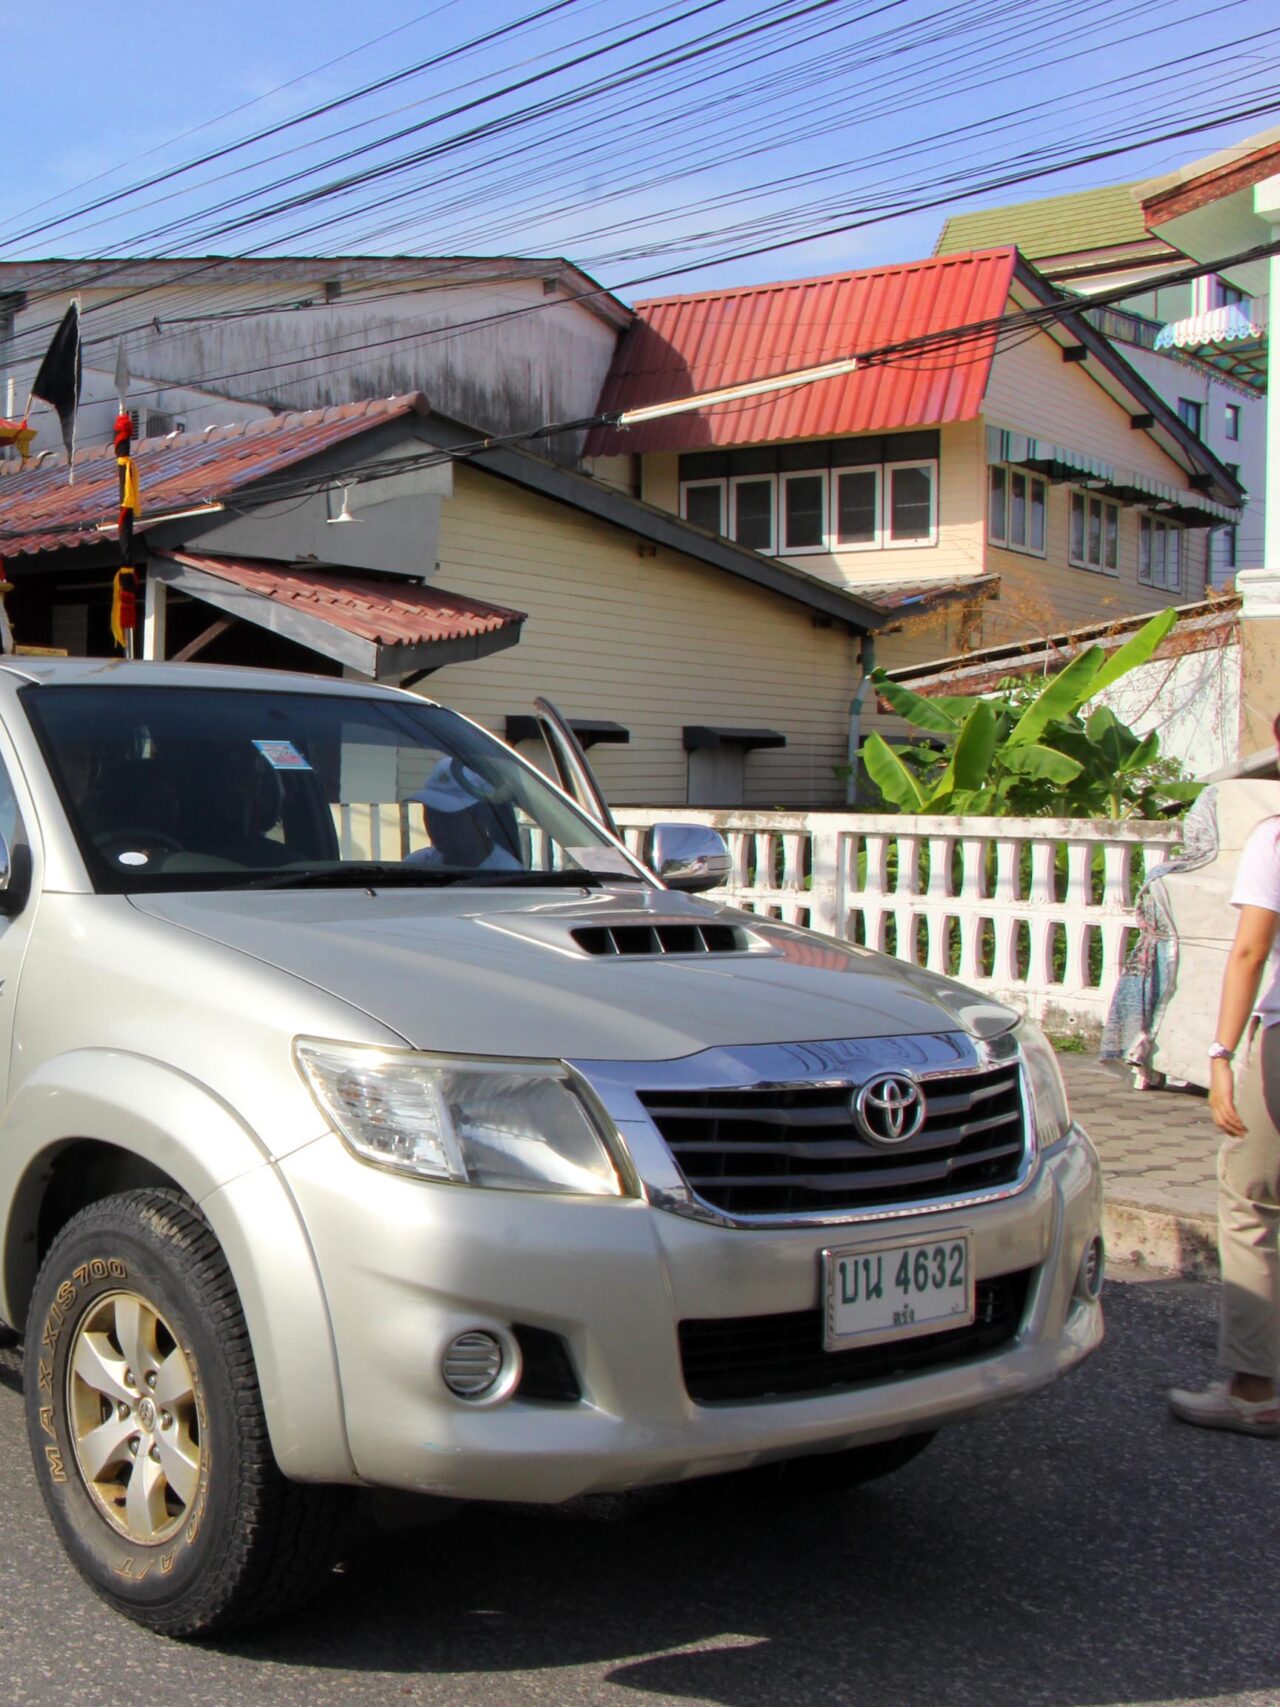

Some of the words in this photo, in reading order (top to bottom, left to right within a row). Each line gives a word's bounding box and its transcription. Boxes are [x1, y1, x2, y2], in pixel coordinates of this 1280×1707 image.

[839, 1254, 884, 1306] บน
[895, 1243, 964, 1296] 4632
[39, 1280, 78, 1484] MAXXIS
[74, 1258, 128, 1287] 700
